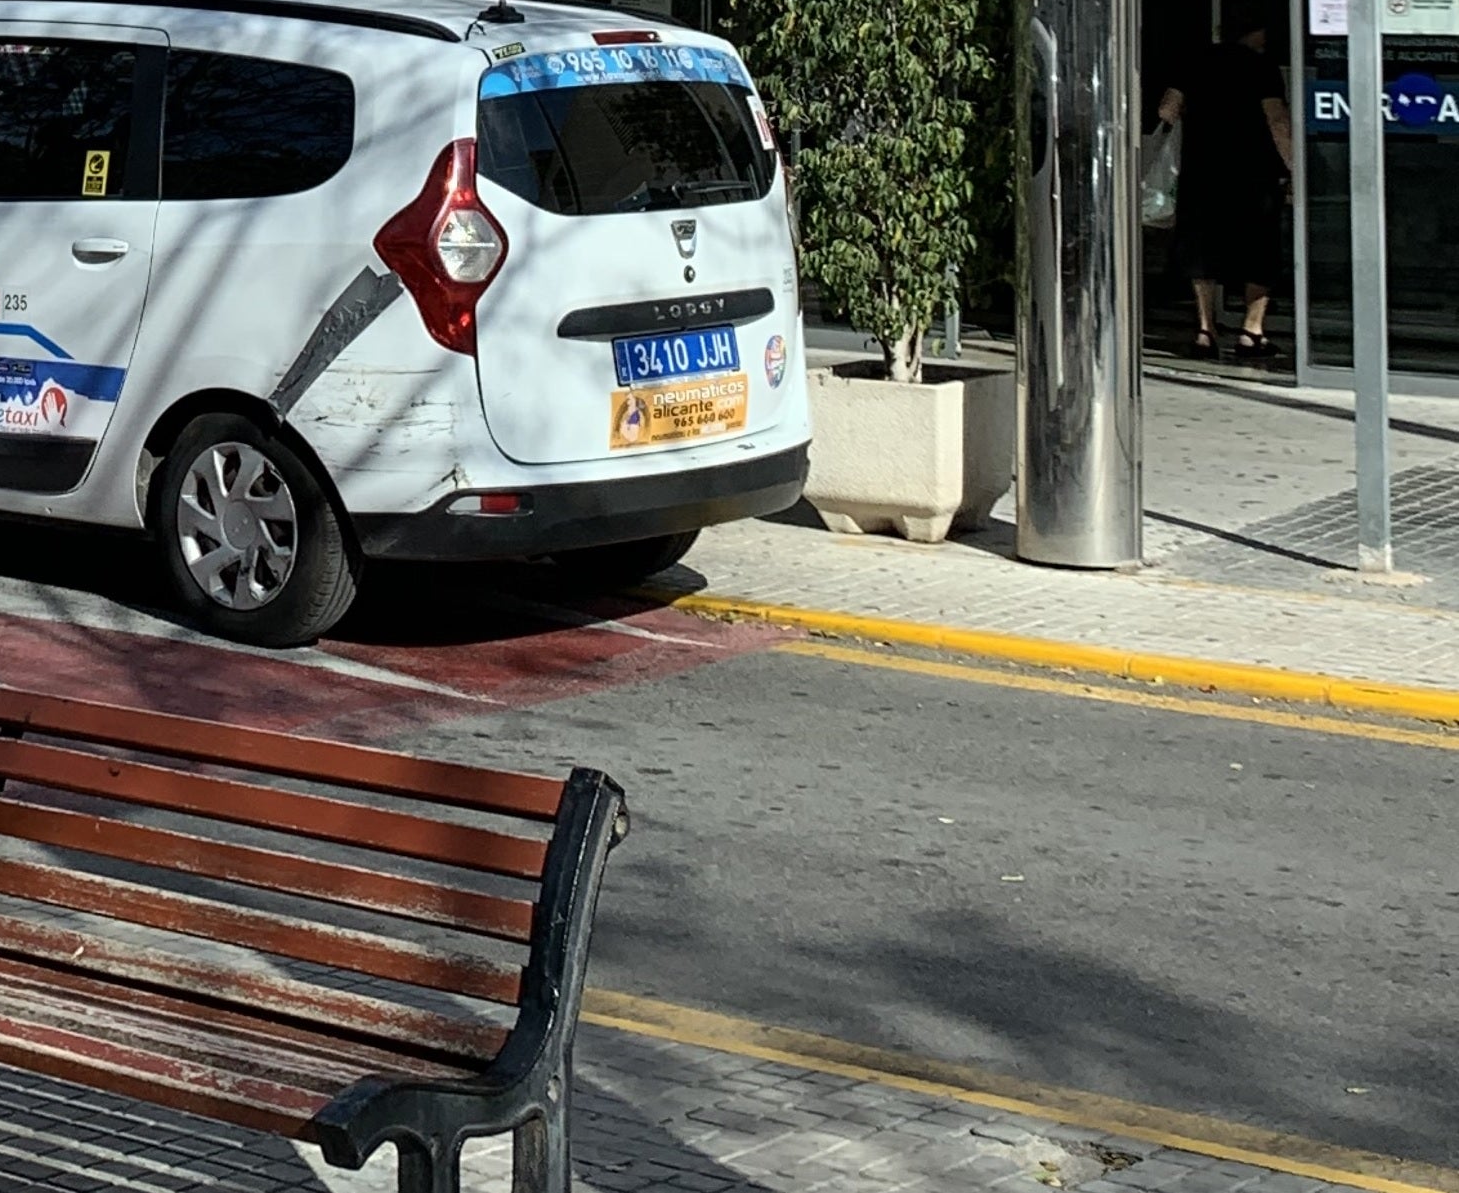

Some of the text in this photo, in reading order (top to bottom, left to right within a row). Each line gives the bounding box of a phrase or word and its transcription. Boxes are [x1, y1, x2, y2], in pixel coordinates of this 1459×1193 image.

[566, 51, 605, 72] 965
[610, 49, 633, 69] 10
[637, 48, 659, 69] 16
[661, 48, 680, 68] 11
[1314, 91, 1459, 123] ENRA
[4, 293, 29, 311] 235
[654, 298, 725, 321] LODGY
[634, 331, 734, 376] 3410 JJH
[653, 400, 714, 420] alicante
[673, 415, 695, 429] 965
